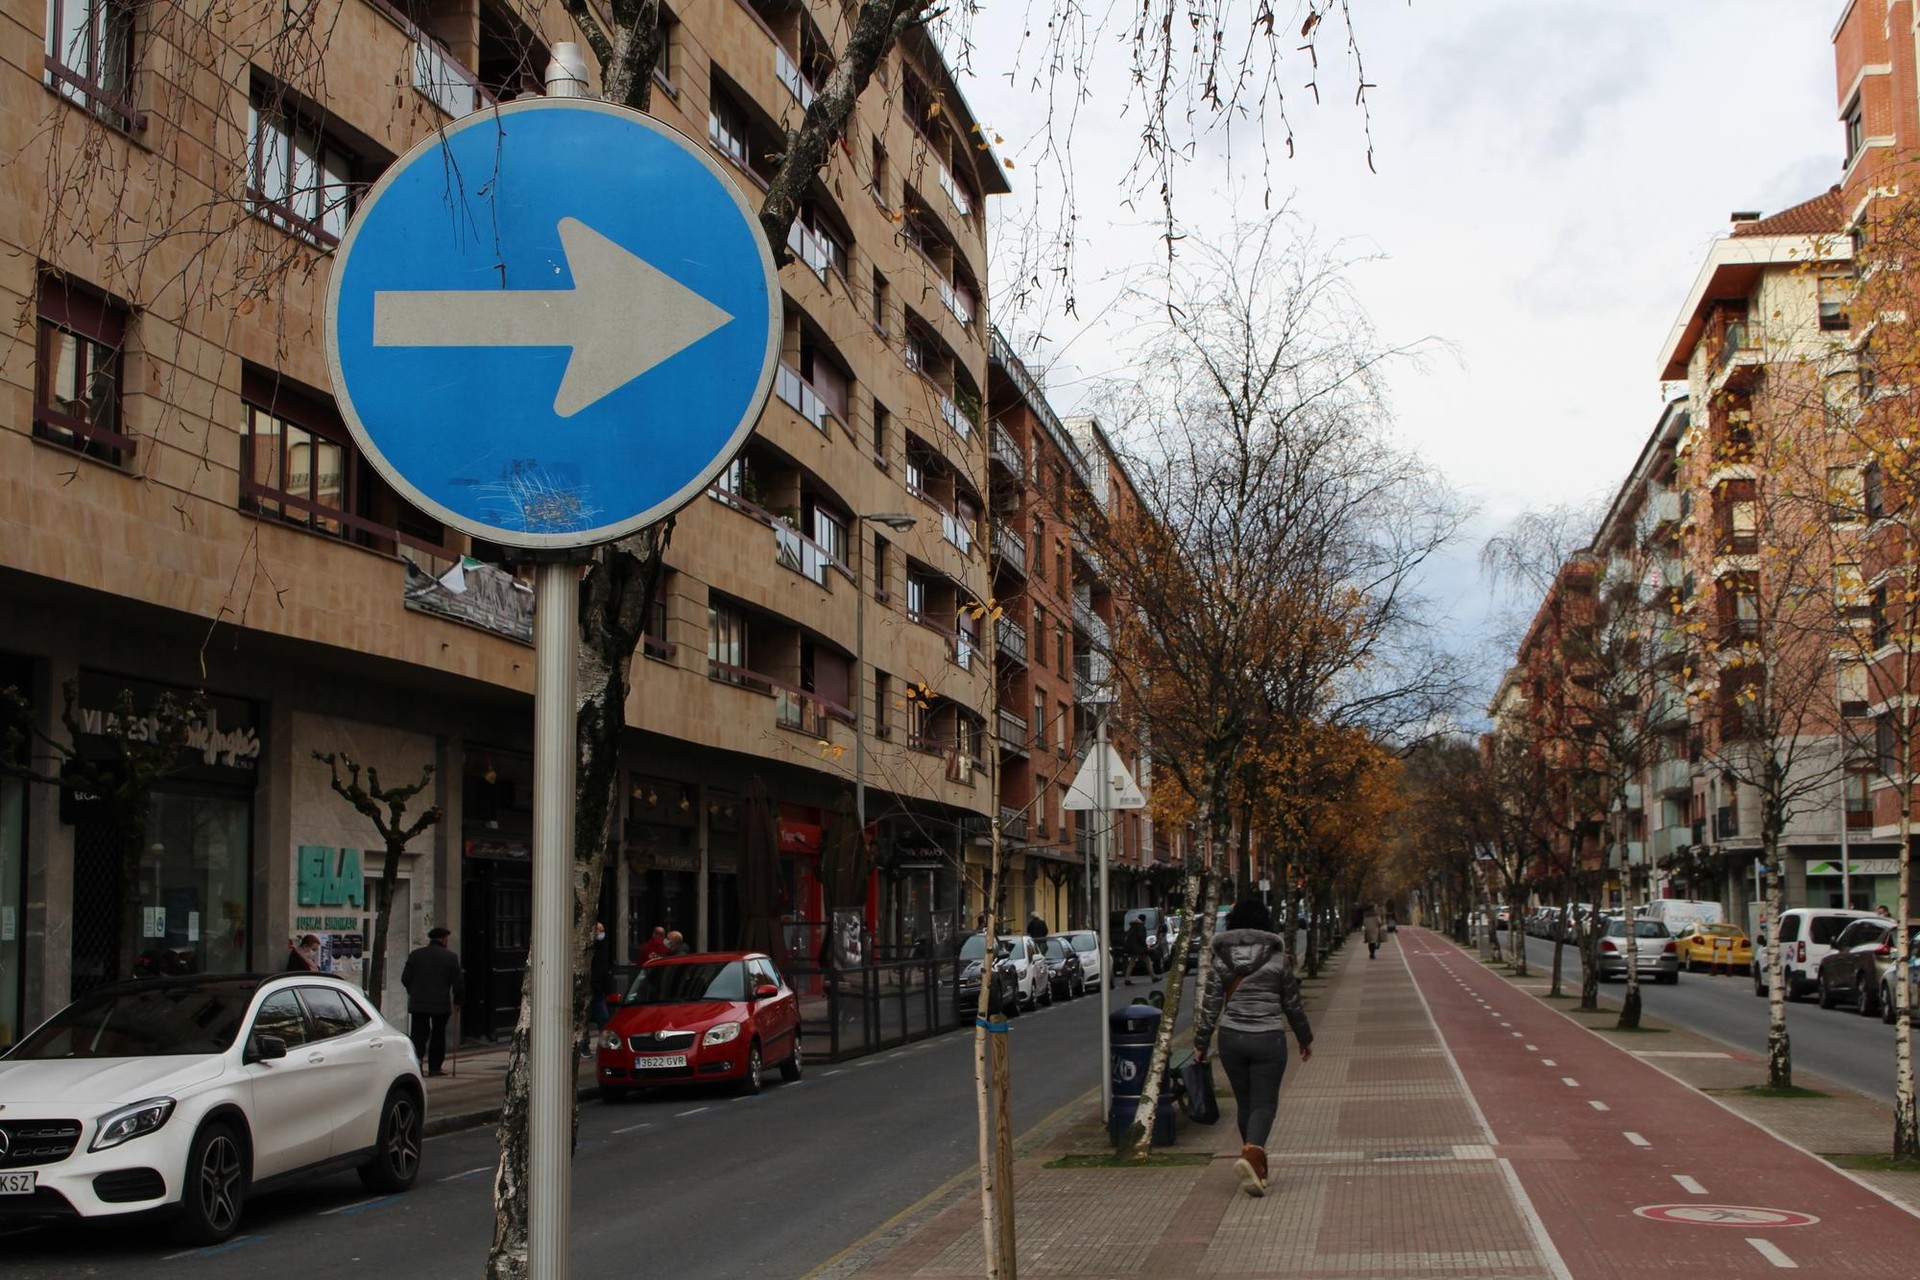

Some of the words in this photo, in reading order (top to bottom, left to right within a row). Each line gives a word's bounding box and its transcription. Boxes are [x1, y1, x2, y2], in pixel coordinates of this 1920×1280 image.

[80, 708, 149, 742] VIAES
[298, 845, 365, 907] ELA
[641, 1057, 664, 1067] 3622
[666, 1056, 684, 1066] GVR
[0, 1175, 29, 1192] KSZ
